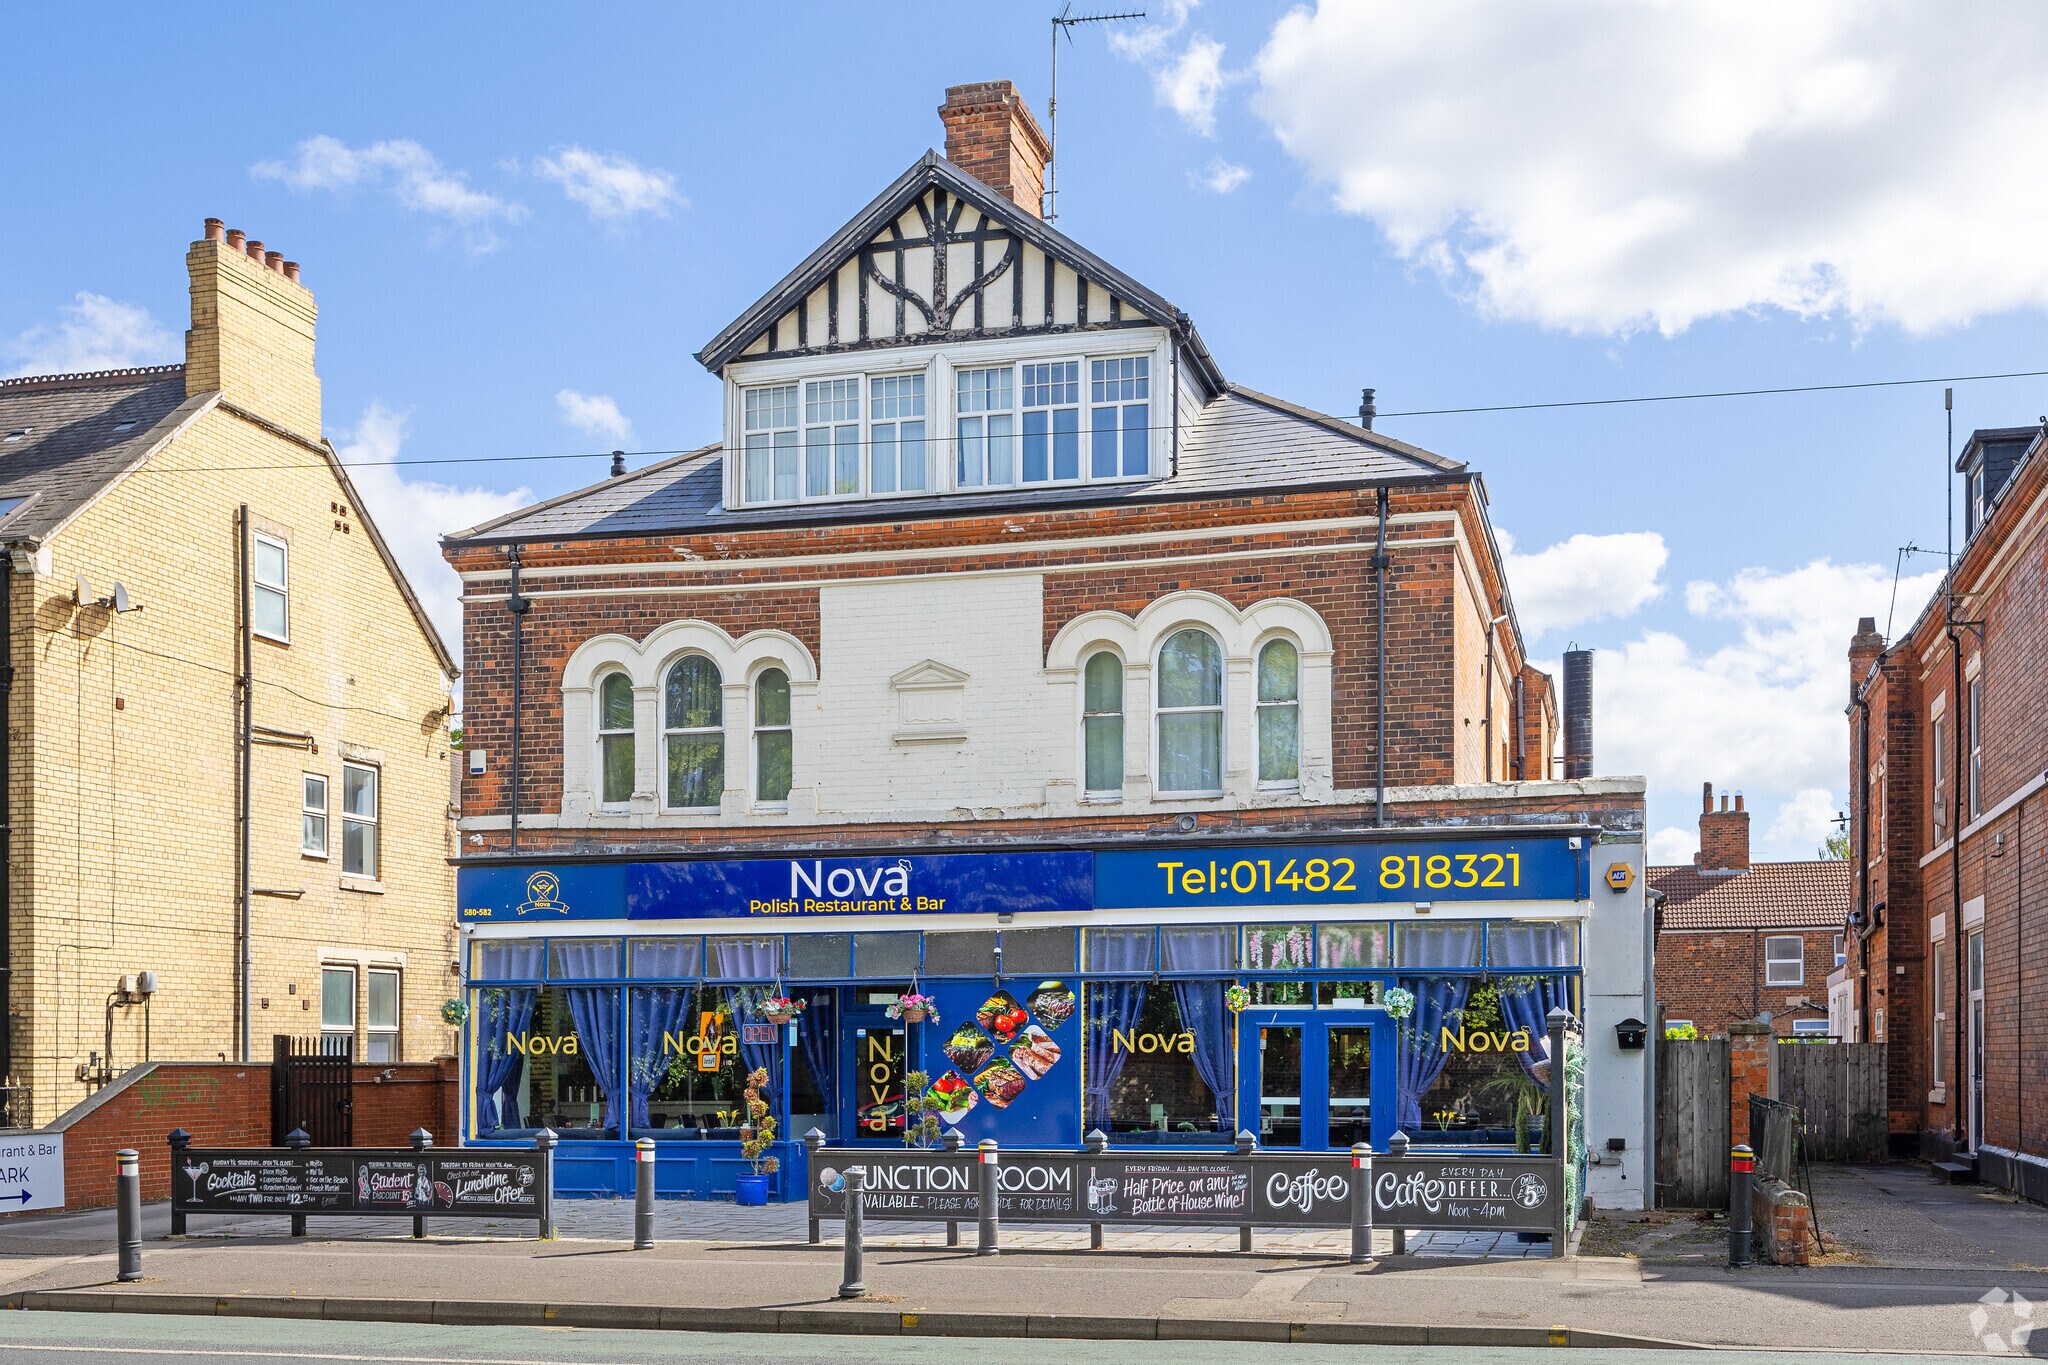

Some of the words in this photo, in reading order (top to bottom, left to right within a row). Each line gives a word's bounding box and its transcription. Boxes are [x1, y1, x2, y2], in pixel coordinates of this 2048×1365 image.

[790, 860, 909, 899] Nova
[1378, 853, 1521, 889] 818321
[1612, 872, 1626, 880] ADT
[464, 908, 492, 916] 580-582
[750, 899, 799, 914] Polish
[804, 898, 896, 913] Restaurant
[901, 897, 912, 911] &
[917, 896, 946, 911] Bar
[506, 1031, 578, 1055] Nova
[663, 1031, 737, 1055] Nova
[743, 1025, 777, 1042] OPEN
[1112, 1028, 1195, 1054] Nova
[1441, 1026, 1529, 1053] Nova
[0, 1146, 25, 1158] rant
[28, 1144, 35, 1157] &
[38, 1143, 57, 1156] Bar
[207, 1170, 256, 1191] Cocktails
[371, 1172, 415, 1191] Student
[852, 1165, 969, 1190] UNCTION
[1441, 1168, 1475, 1177] EVERY
[1480, 1168, 1504, 1177] DAY
[456, 1172, 508, 1200] Lunchtime
[495, 1186, 524, 1204] Offer
[1123, 1178, 1148, 1198] Half
[1151, 1177, 1186, 1195] Price
[1189, 1178, 1204, 1193] on
[1206, 1176, 1230, 1195] any
[1266, 1168, 1348, 1214] Coffee
[1375, 1170, 1446, 1214] Cake
[248, 1193, 263, 1203] TWO
[927, 1196, 961, 1210] PLEASE
[1131, 1195, 1166, 1216] Bottle
[1167, 1195, 1180, 1212] of
[1180, 1193, 1214, 1211] House
[1214, 1189, 1245, 1209] Wine!
[1447, 1202, 1470, 1218] Noon
